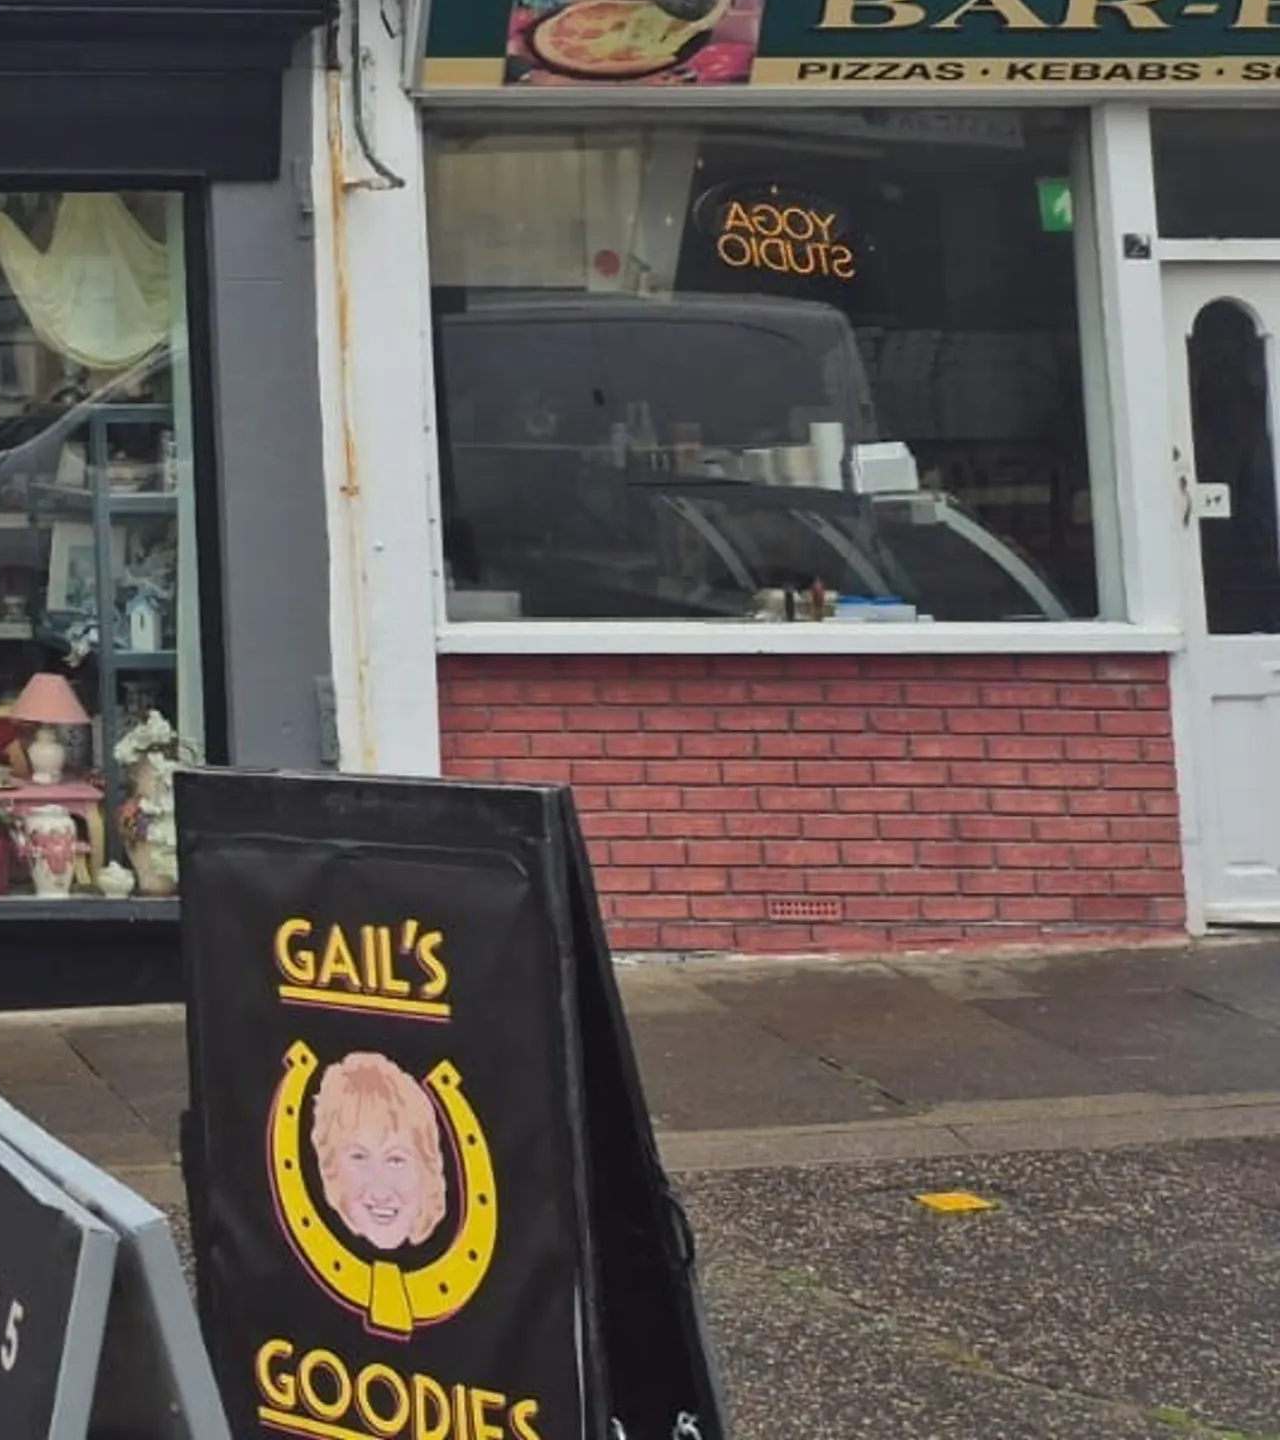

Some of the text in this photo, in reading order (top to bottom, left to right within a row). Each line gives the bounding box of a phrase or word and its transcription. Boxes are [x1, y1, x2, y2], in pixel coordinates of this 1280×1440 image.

[796, 61, 1280, 81] PIZZAS KEBABS S
[273, 917, 449, 1002] GAIL'S
[0, 1299, 24, 1371] 5
[255, 1339, 542, 1440] GOODIES
